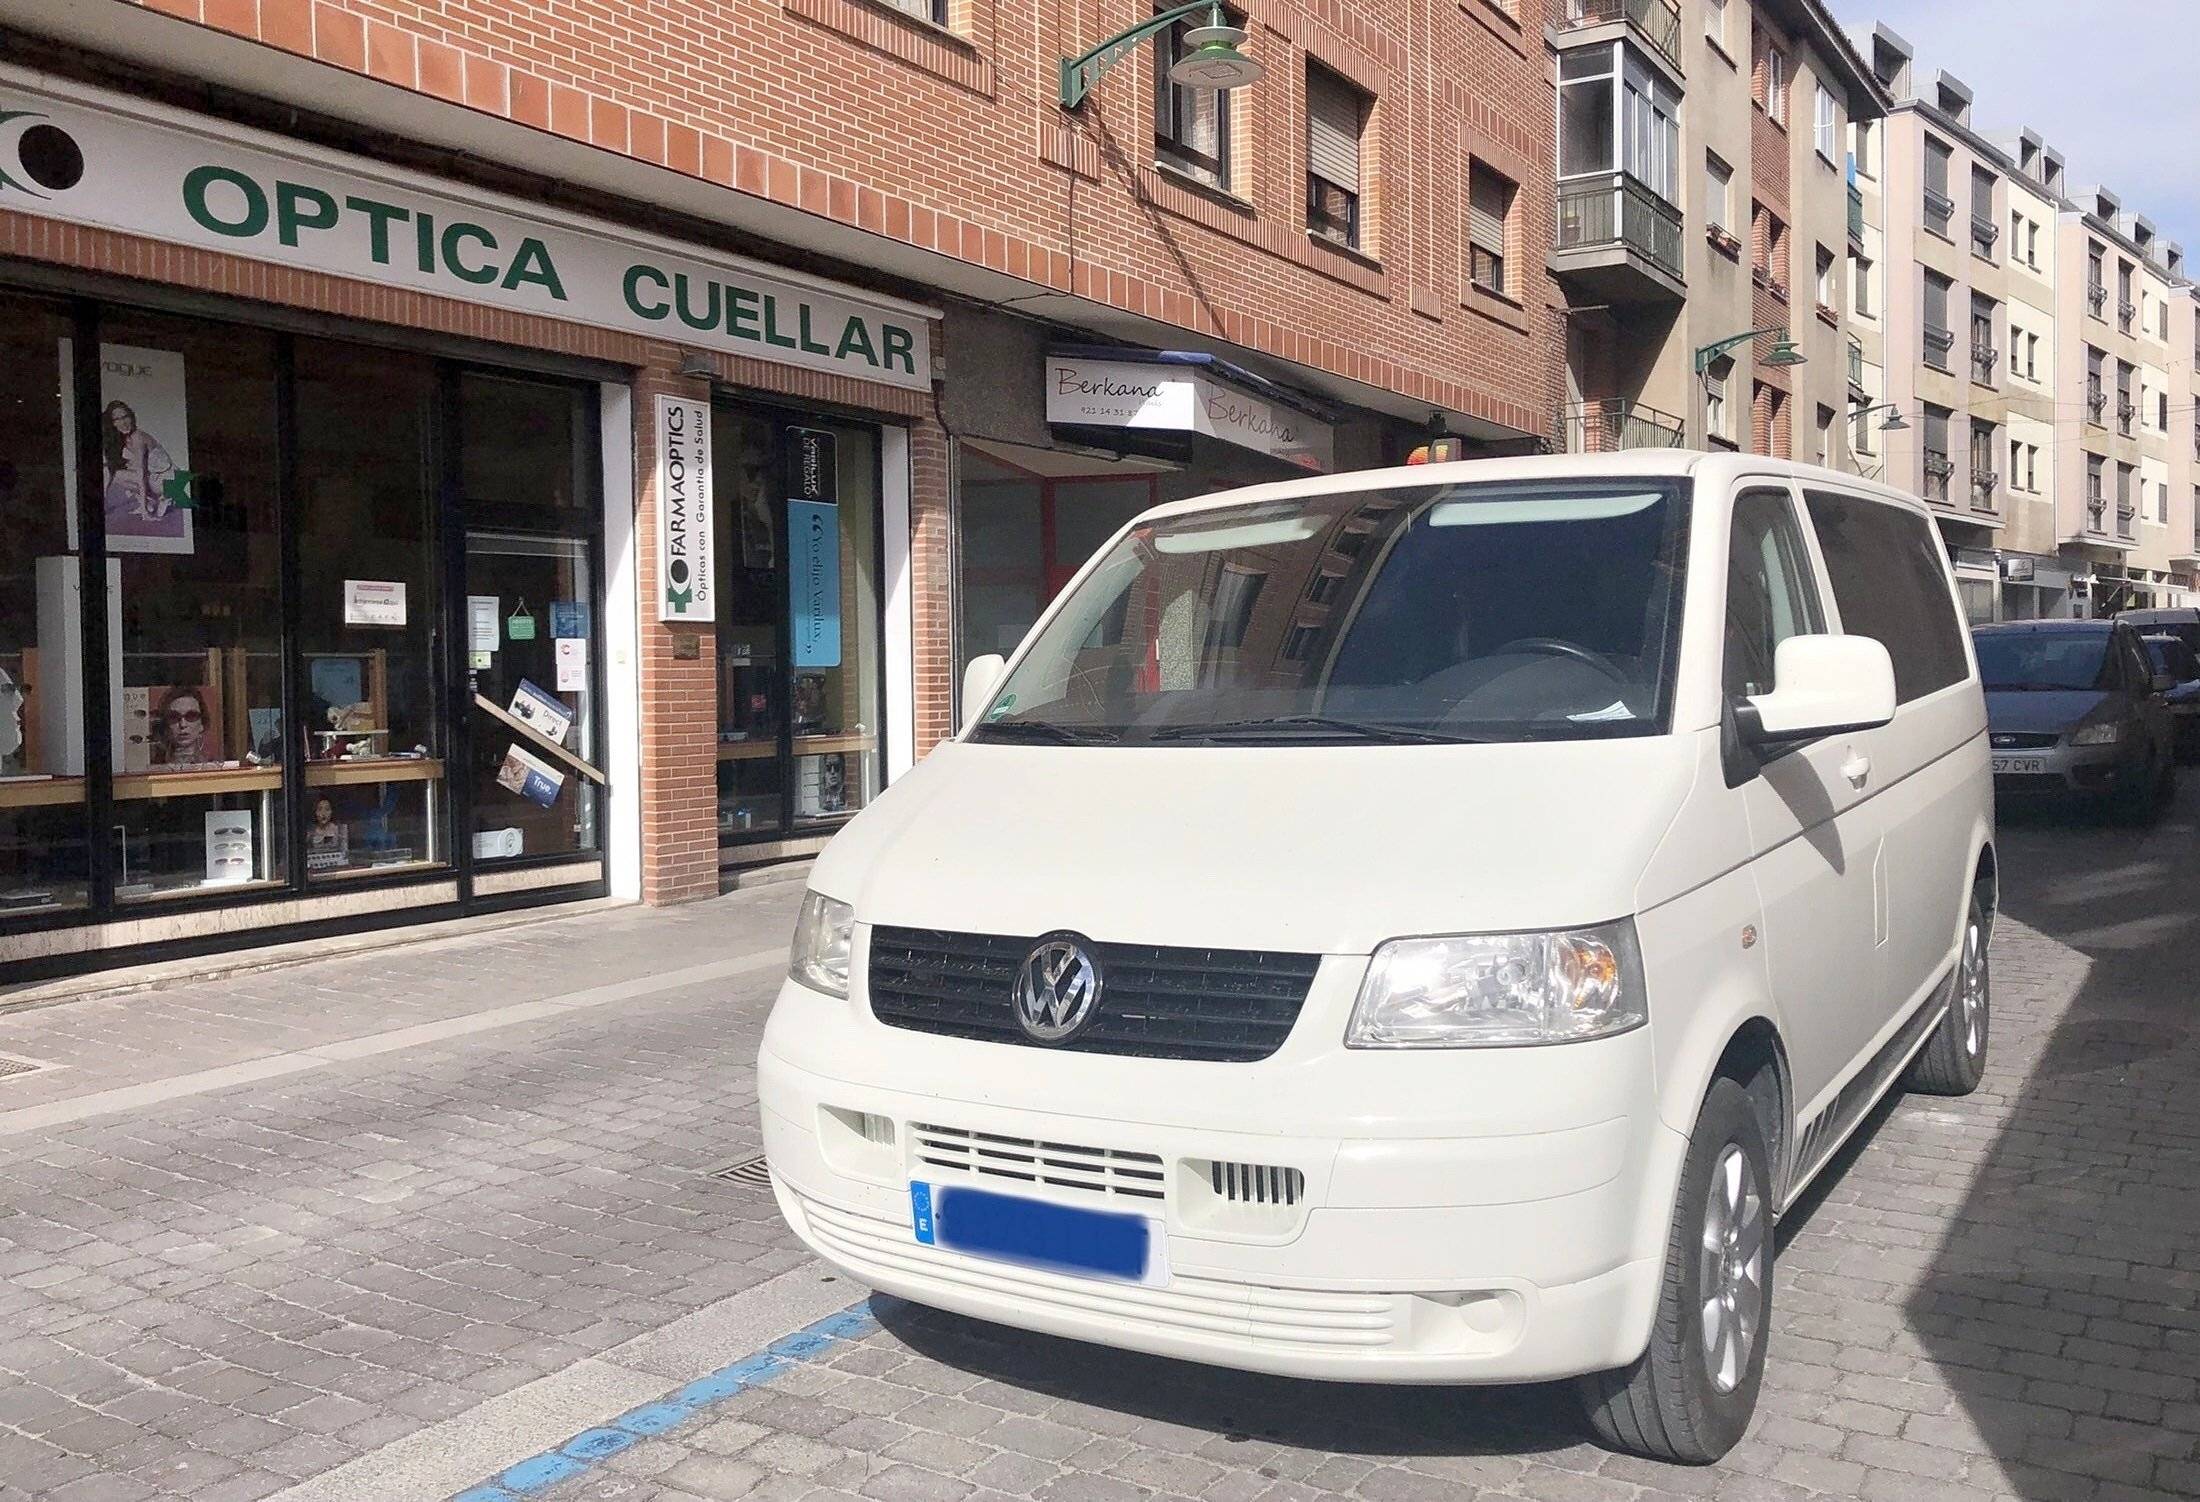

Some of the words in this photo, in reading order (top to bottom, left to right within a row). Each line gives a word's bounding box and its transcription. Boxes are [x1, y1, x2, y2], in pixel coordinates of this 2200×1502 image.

[182, 164, 568, 302] OPTICA
[622, 263, 916, 376] CUELLAR
[102, 361, 153, 378] ogue
[1054, 367, 1165, 398] Berkana
[1205, 378, 1298, 443] Berkana
[694, 410, 704, 445] Salud
[694, 448, 704, 464] de
[668, 405, 687, 557] FARMAOPTICS
[698, 531, 706, 551] con
[2013, 759, 2040, 771] CVR
[918, 1217, 929, 1233] E
